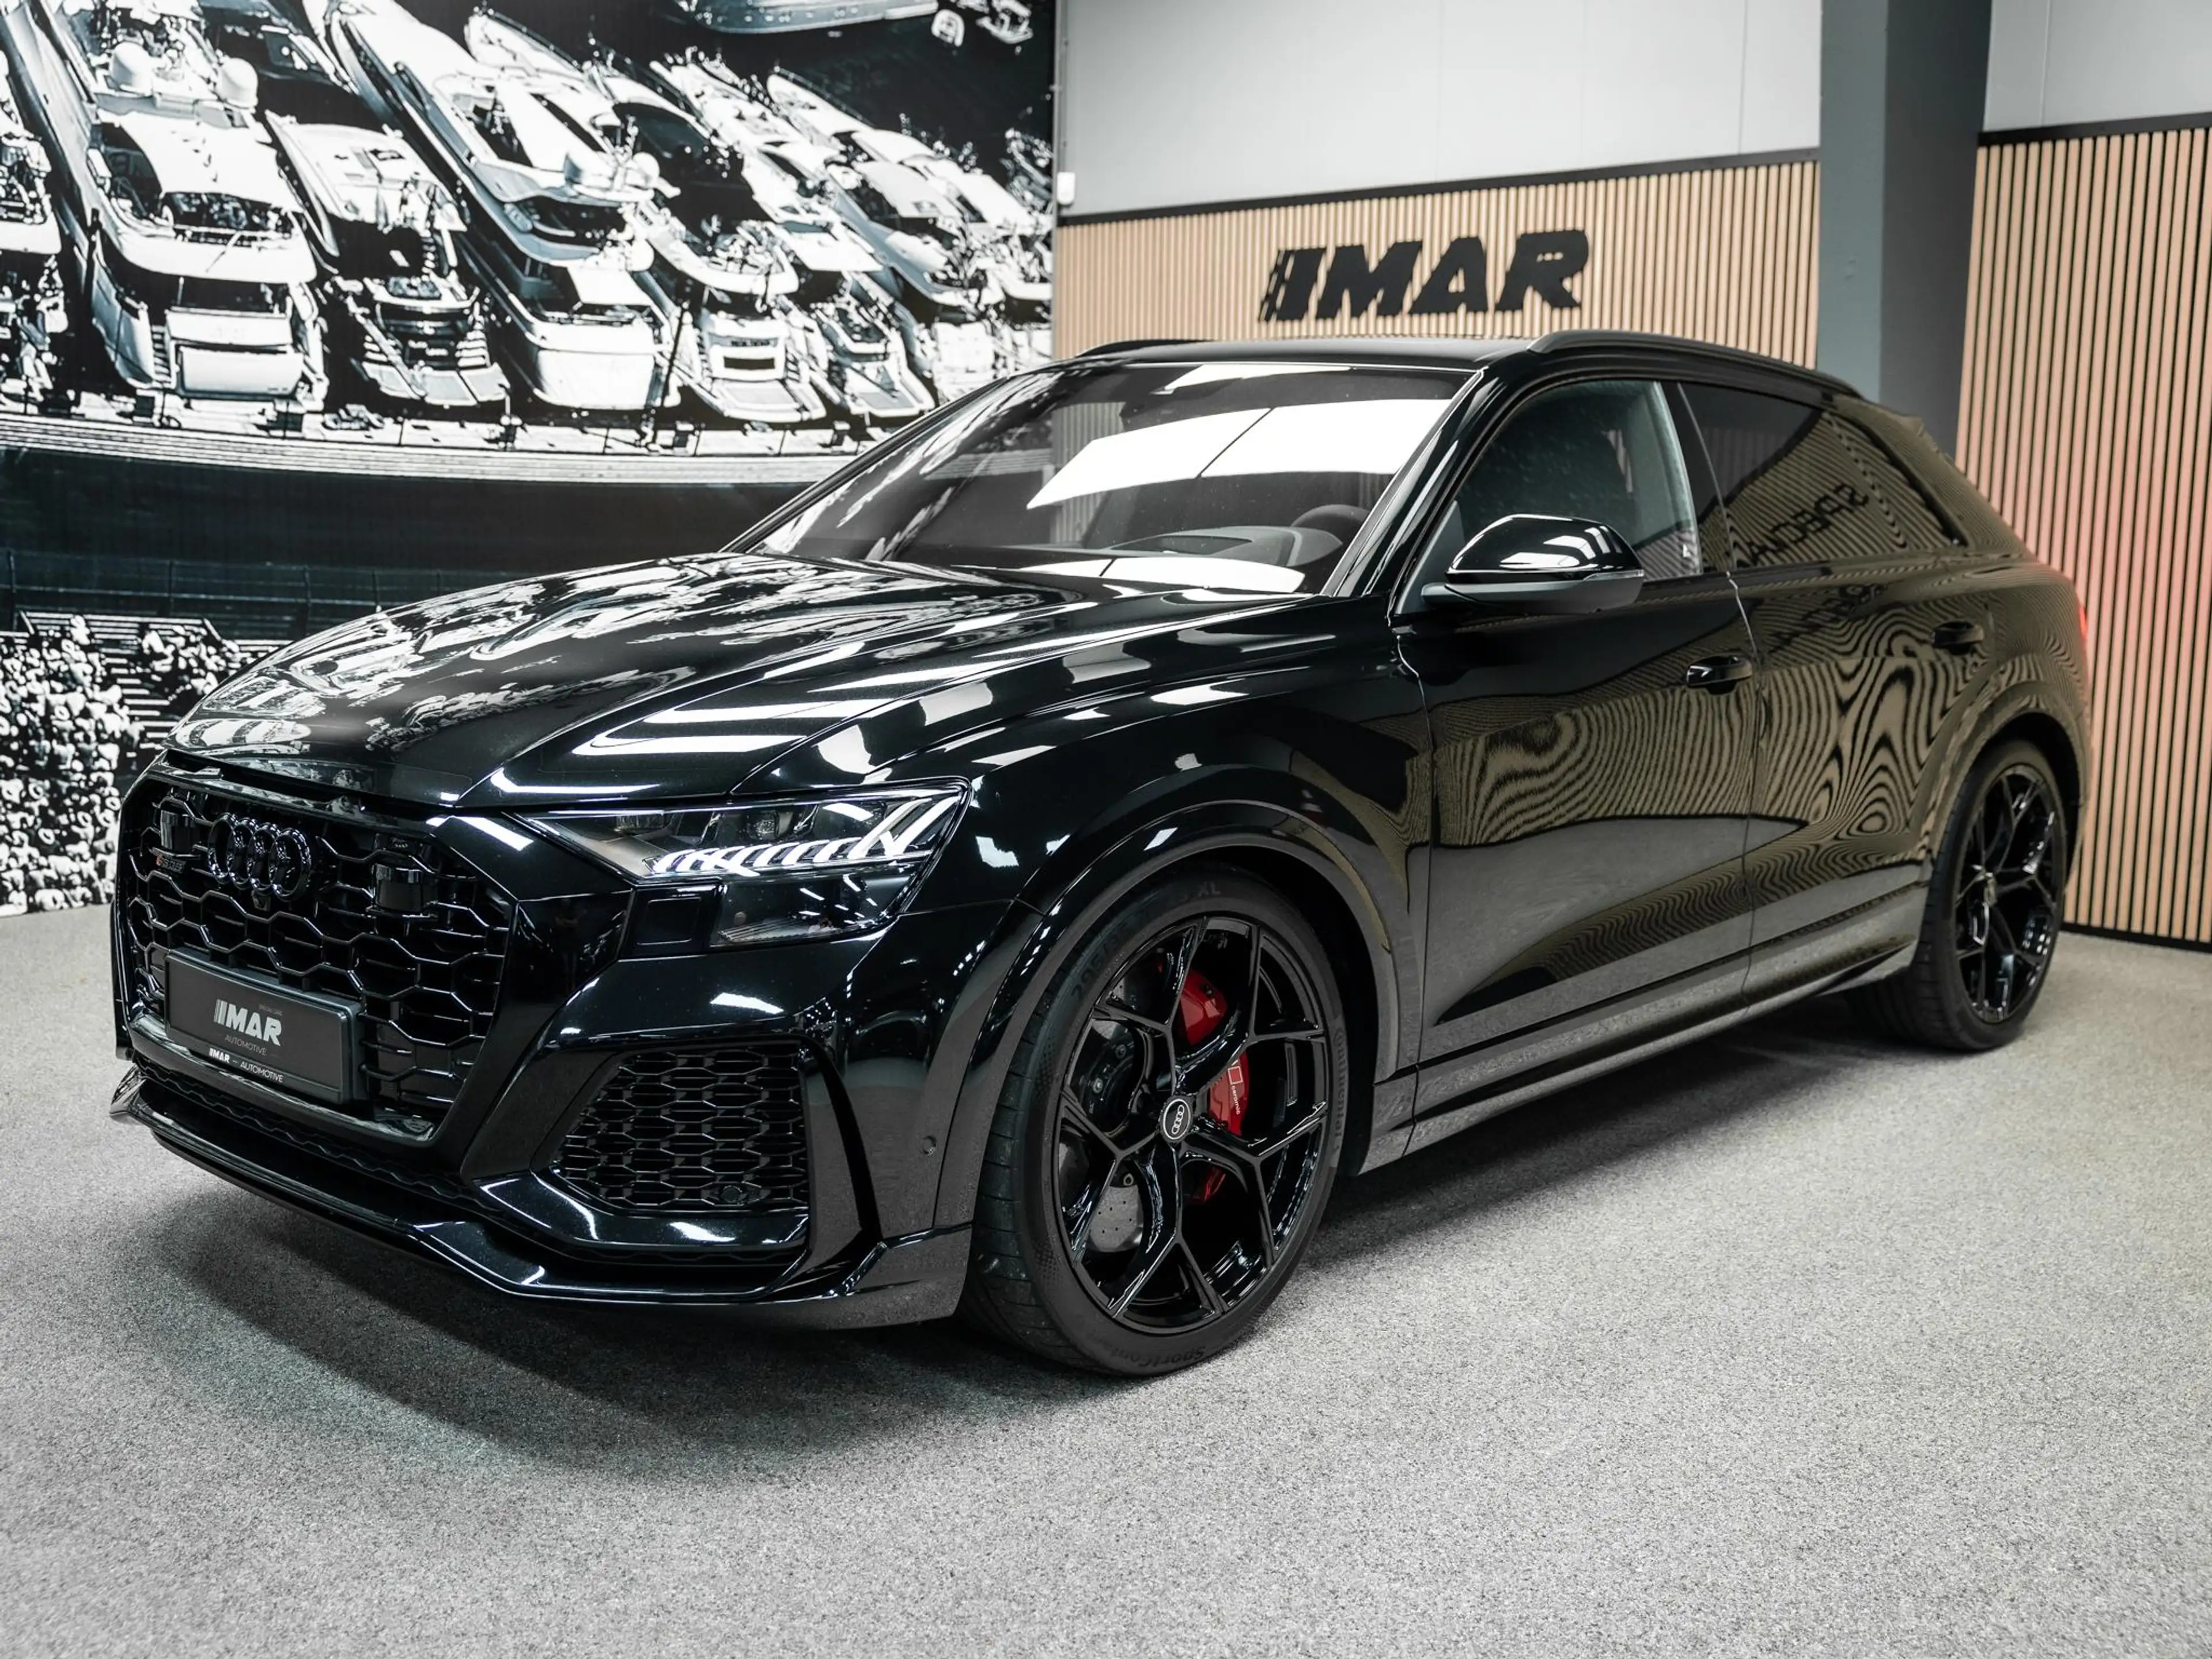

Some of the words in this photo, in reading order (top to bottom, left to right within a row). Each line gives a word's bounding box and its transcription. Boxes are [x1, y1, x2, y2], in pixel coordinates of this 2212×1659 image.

[1259, 228, 1589, 323] IMAR
[214, 998, 282, 1047] IMAR
[209, 1047, 230, 1063] IMAR
[240, 1061, 284, 1083] AUTOMOTIVE
[225, 1035, 267, 1056] AUTOMOTIVE
